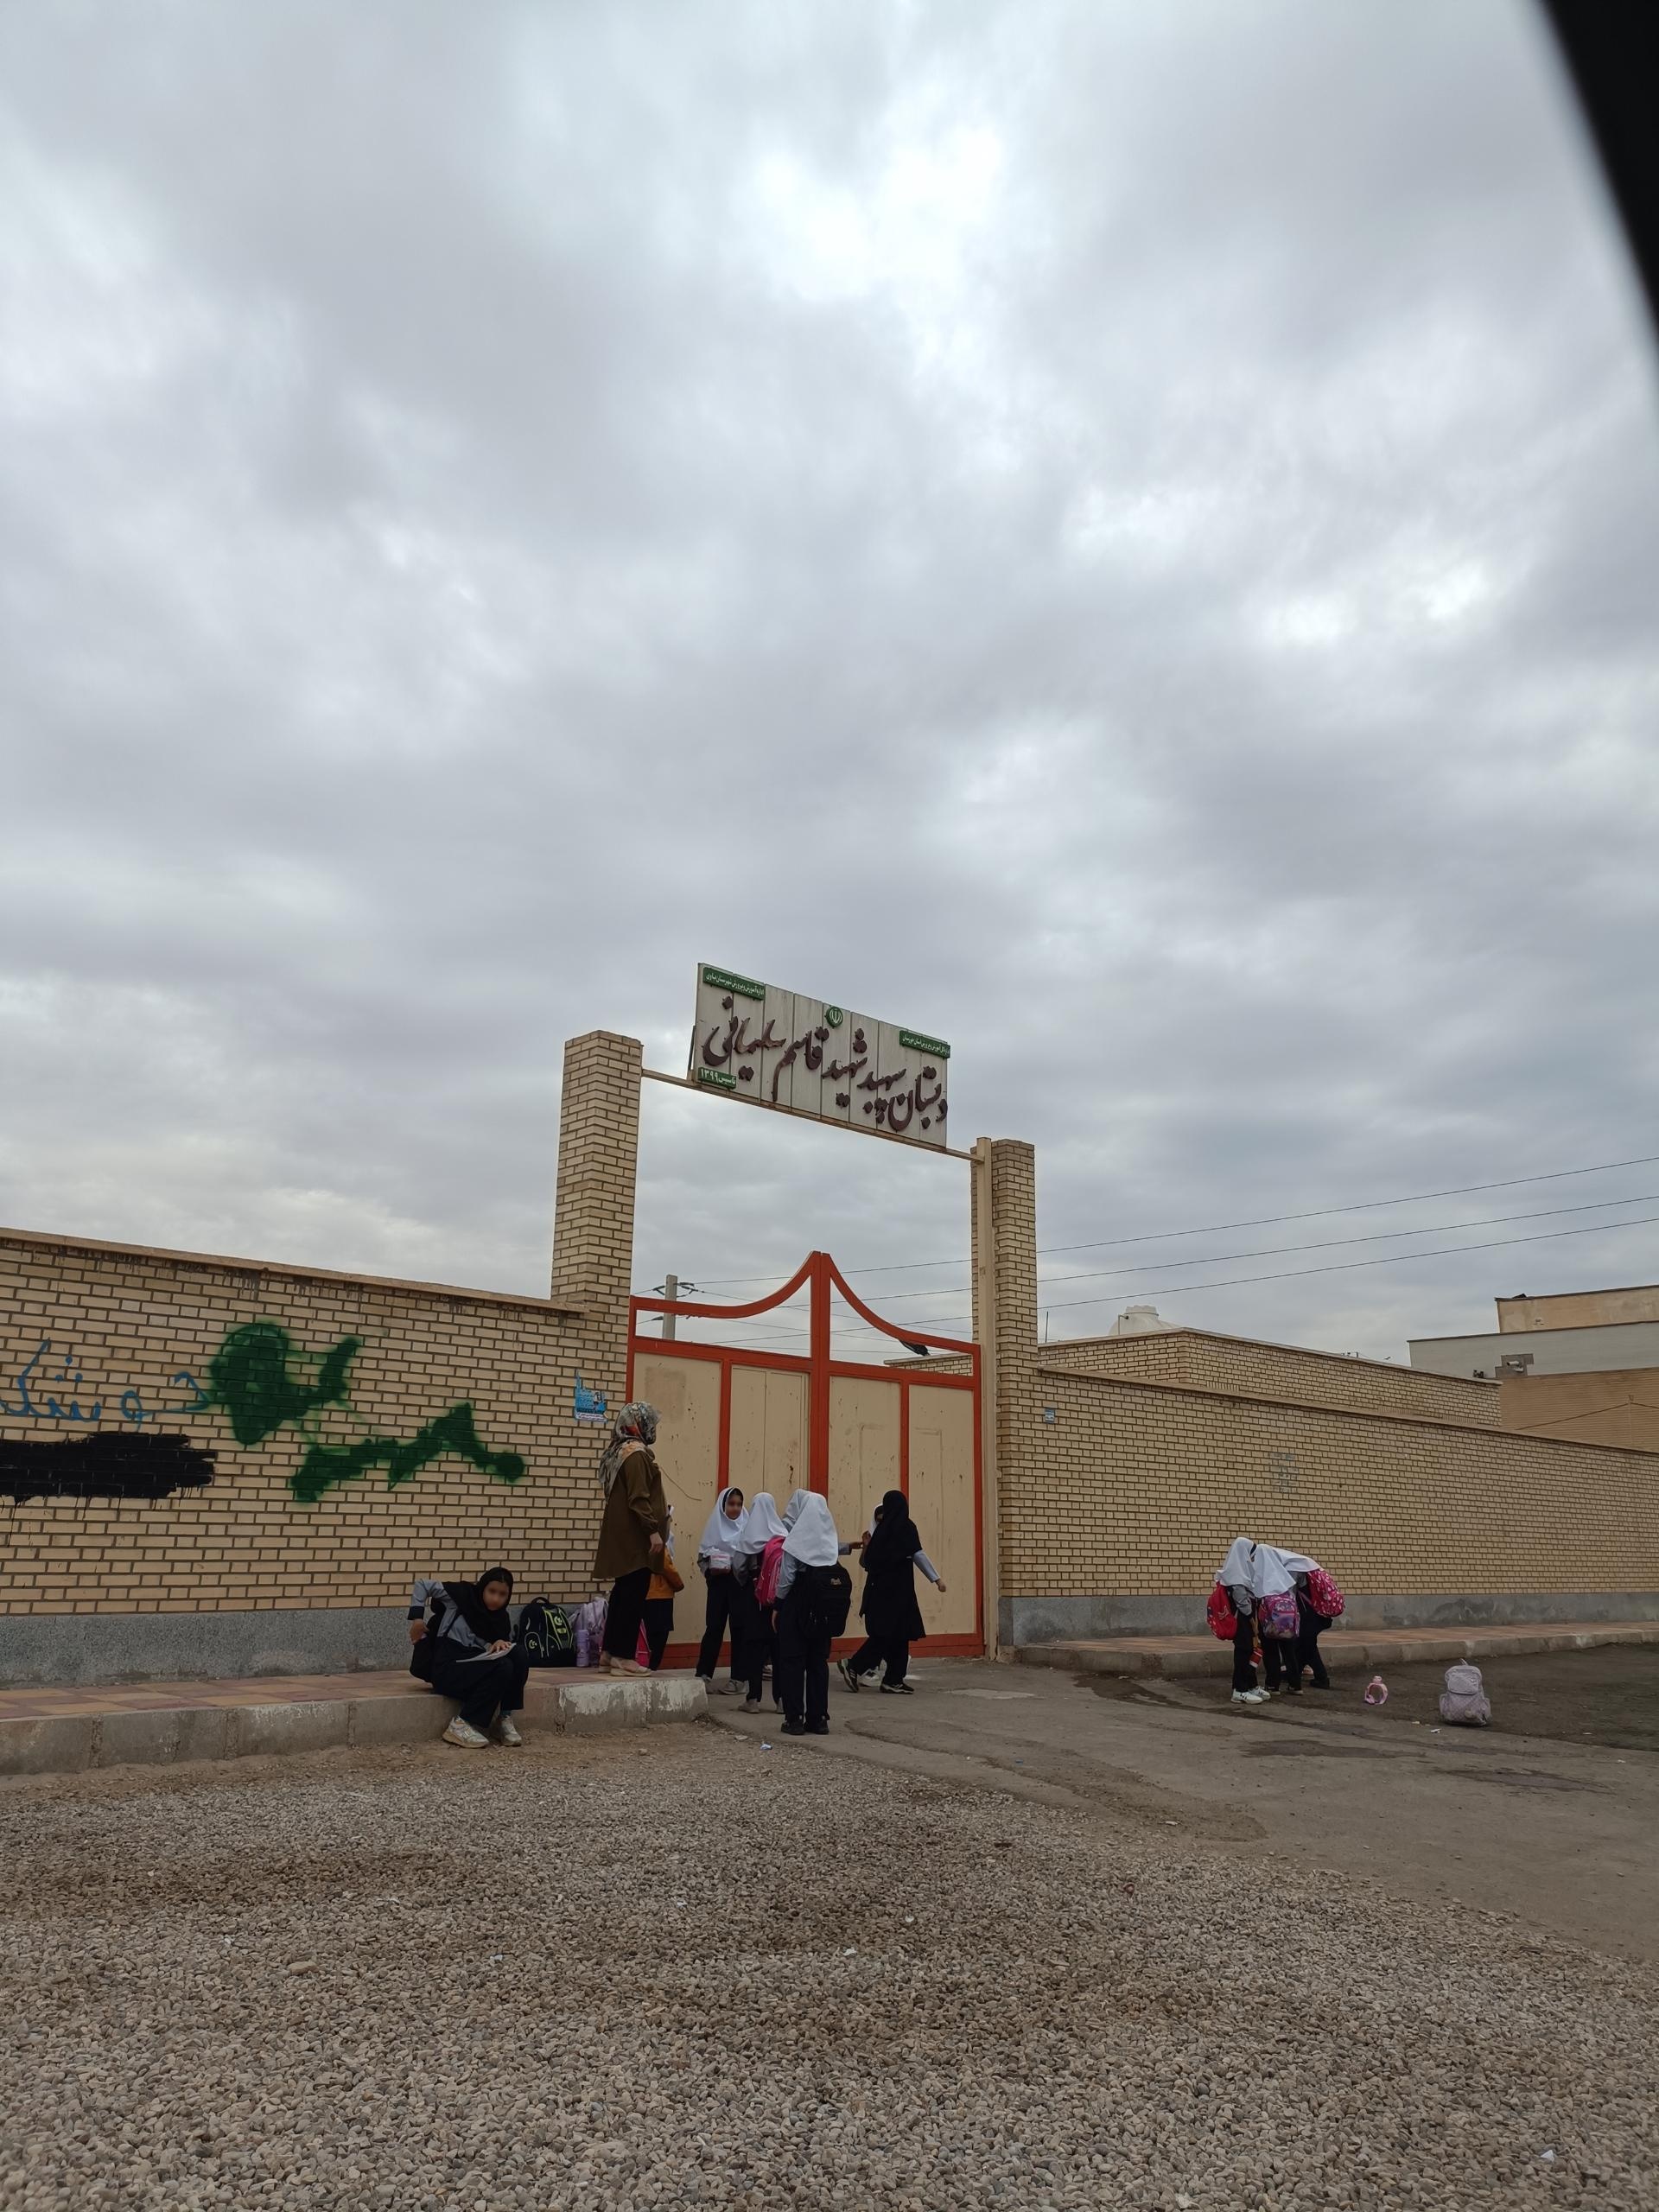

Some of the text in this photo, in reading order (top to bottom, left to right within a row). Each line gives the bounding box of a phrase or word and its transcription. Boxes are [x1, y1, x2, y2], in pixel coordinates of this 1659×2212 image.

[716, 975, 732, 987] شهرستان
[702, 995, 787, 1082] سلیمانی
[772, 1026, 830, 1103] قاسم
[822, 1027, 868, 1109] شهید
[701, 1068, 719, 1084] ۱۳۹۹
[887, 1065, 949, 1133] دبستان
